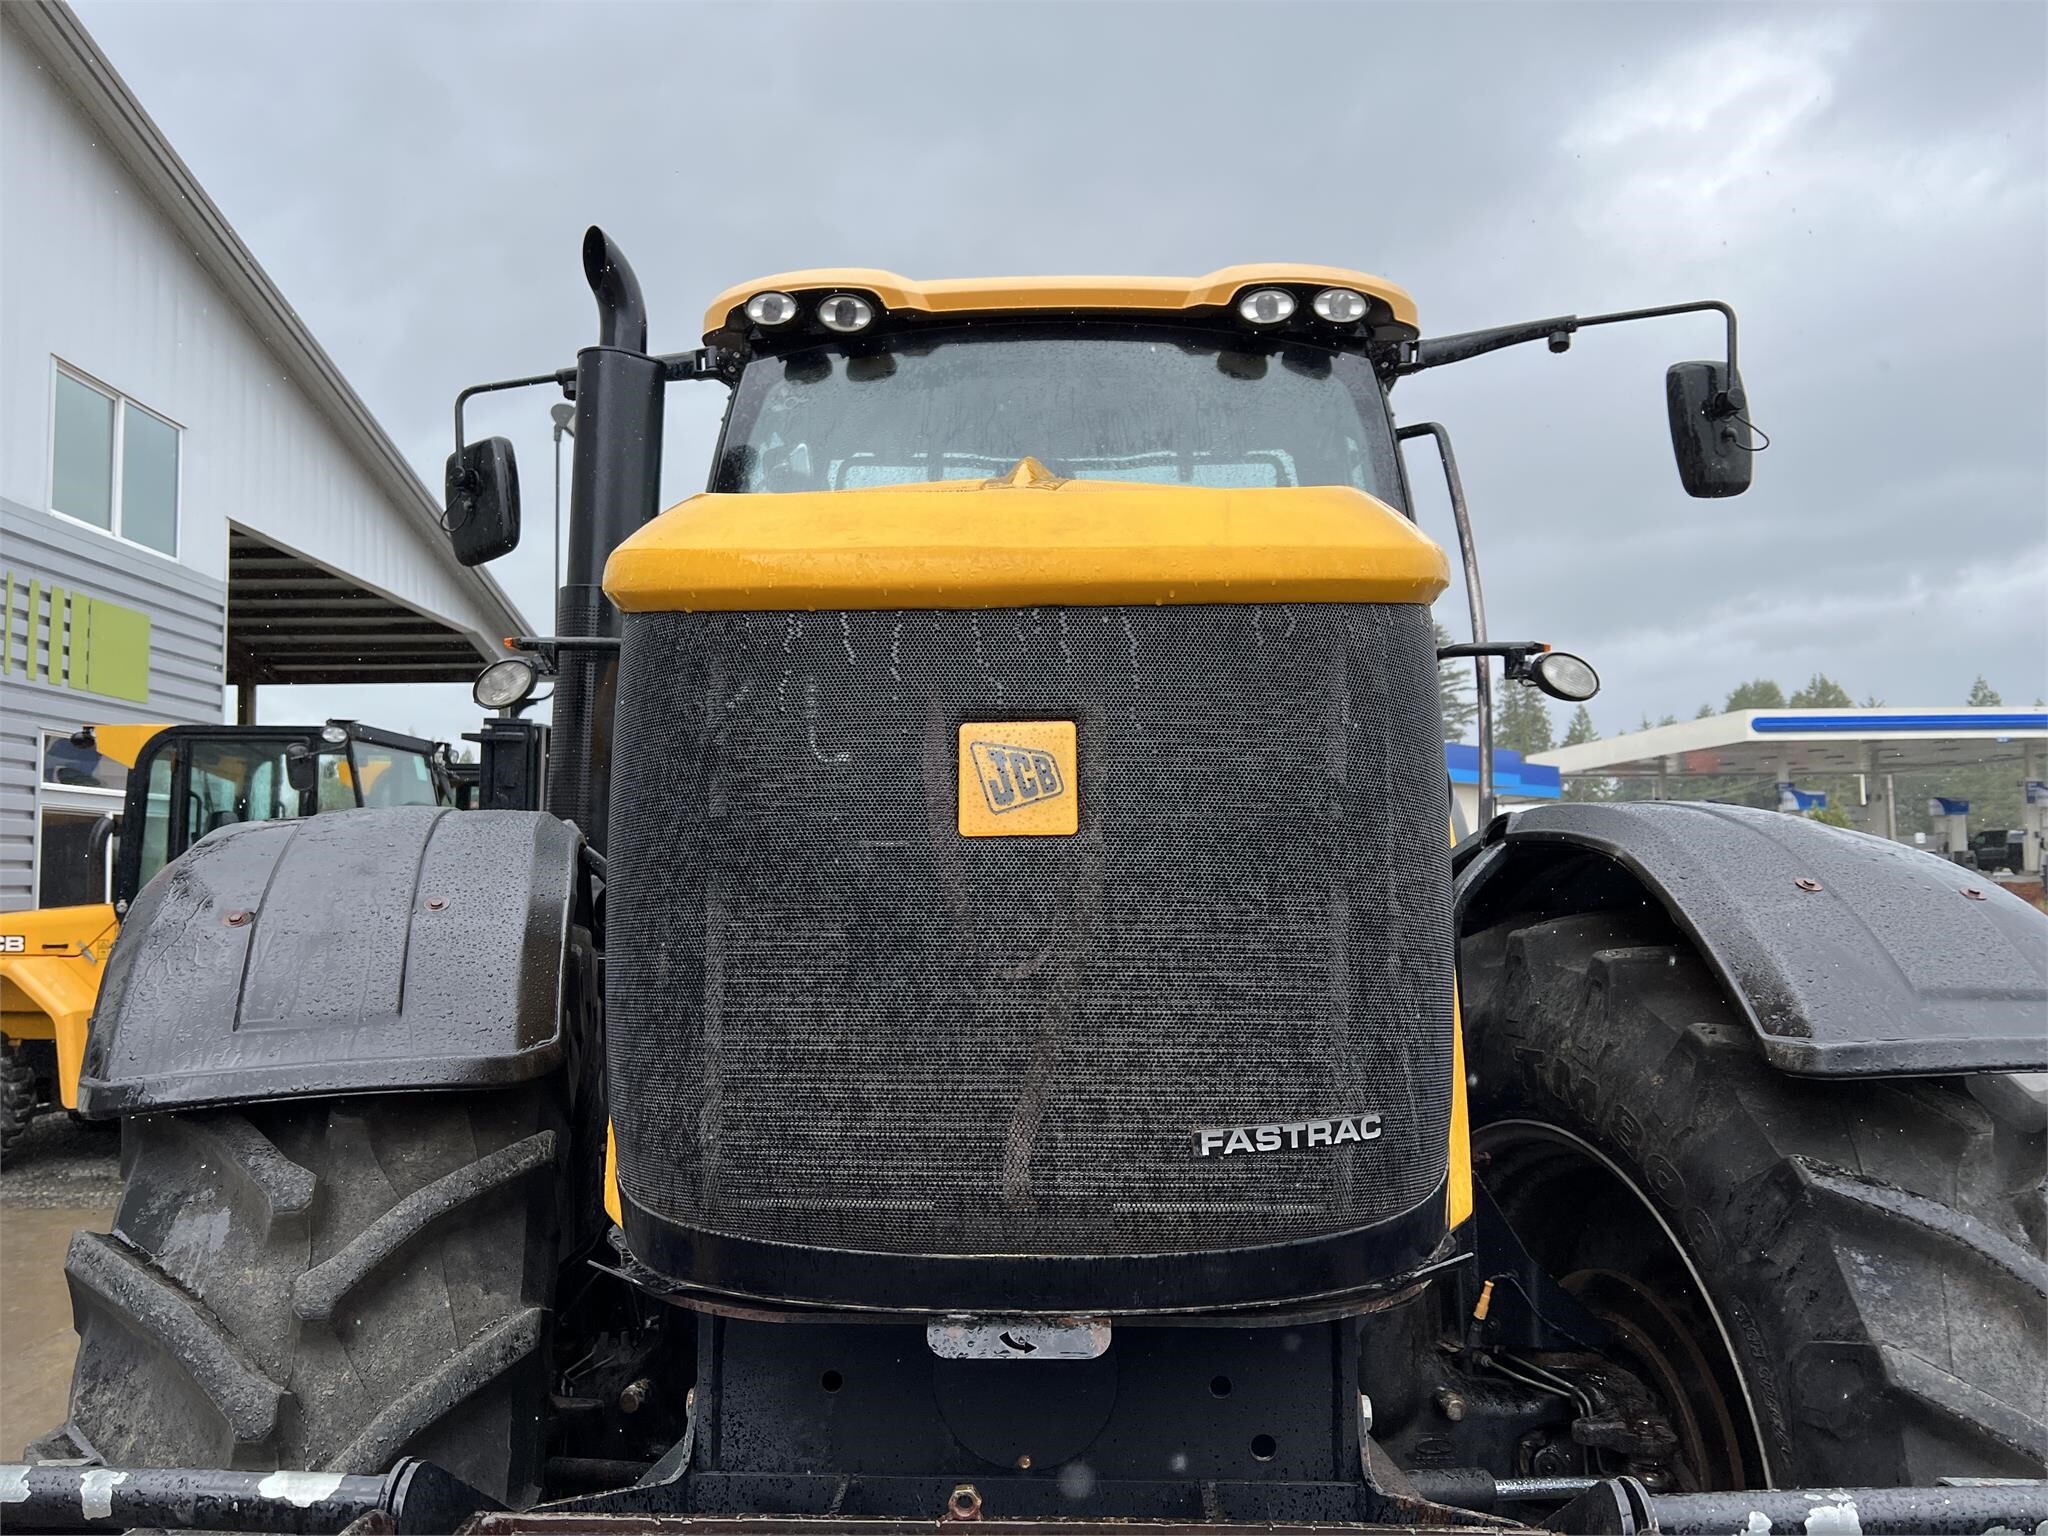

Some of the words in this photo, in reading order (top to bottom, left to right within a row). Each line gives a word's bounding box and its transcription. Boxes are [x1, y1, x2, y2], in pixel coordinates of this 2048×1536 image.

[987, 749, 1058, 805] JCB
[0, 936, 25, 952] B
[1201, 1115, 1382, 1156] FASTRAC
